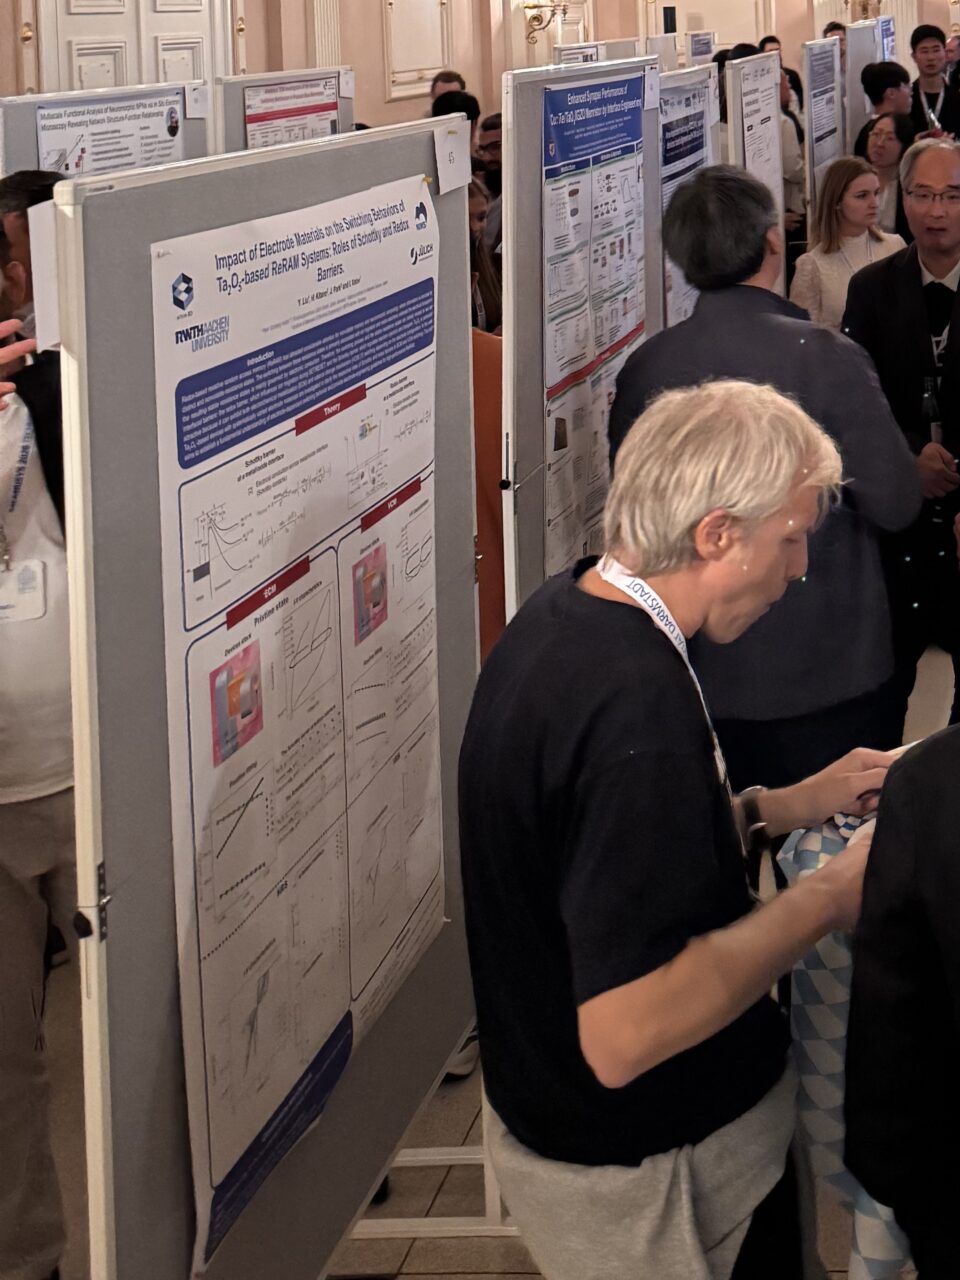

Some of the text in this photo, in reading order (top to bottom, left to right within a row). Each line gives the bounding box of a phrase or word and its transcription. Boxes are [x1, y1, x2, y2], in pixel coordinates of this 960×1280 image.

[215, 199, 406, 271] Impact of Electrode Materials on the Switching Behaviors of
[272, 254, 300, 278] ReRAM
[301, 246, 331, 270] Systems:
[332, 237, 350, 256] Roles
[351, 236, 357, 250] of
[357, 226, 382, 248] Schottky
[381, 224, 393, 242] and
[392, 218, 410, 238] Redox
[317, 262, 345, 282] Barriers.
[175, 324, 204, 344] RWTH
[203, 315, 230, 334] AACHEN
[192, 329, 229, 352] UNIVERSITY
[324, 401, 341, 416] Theory
[262, 583, 277, 599] ECM
[254, 596, 290, 627] Pristine state
[626, 580, 676, 635] DARMSTADT
